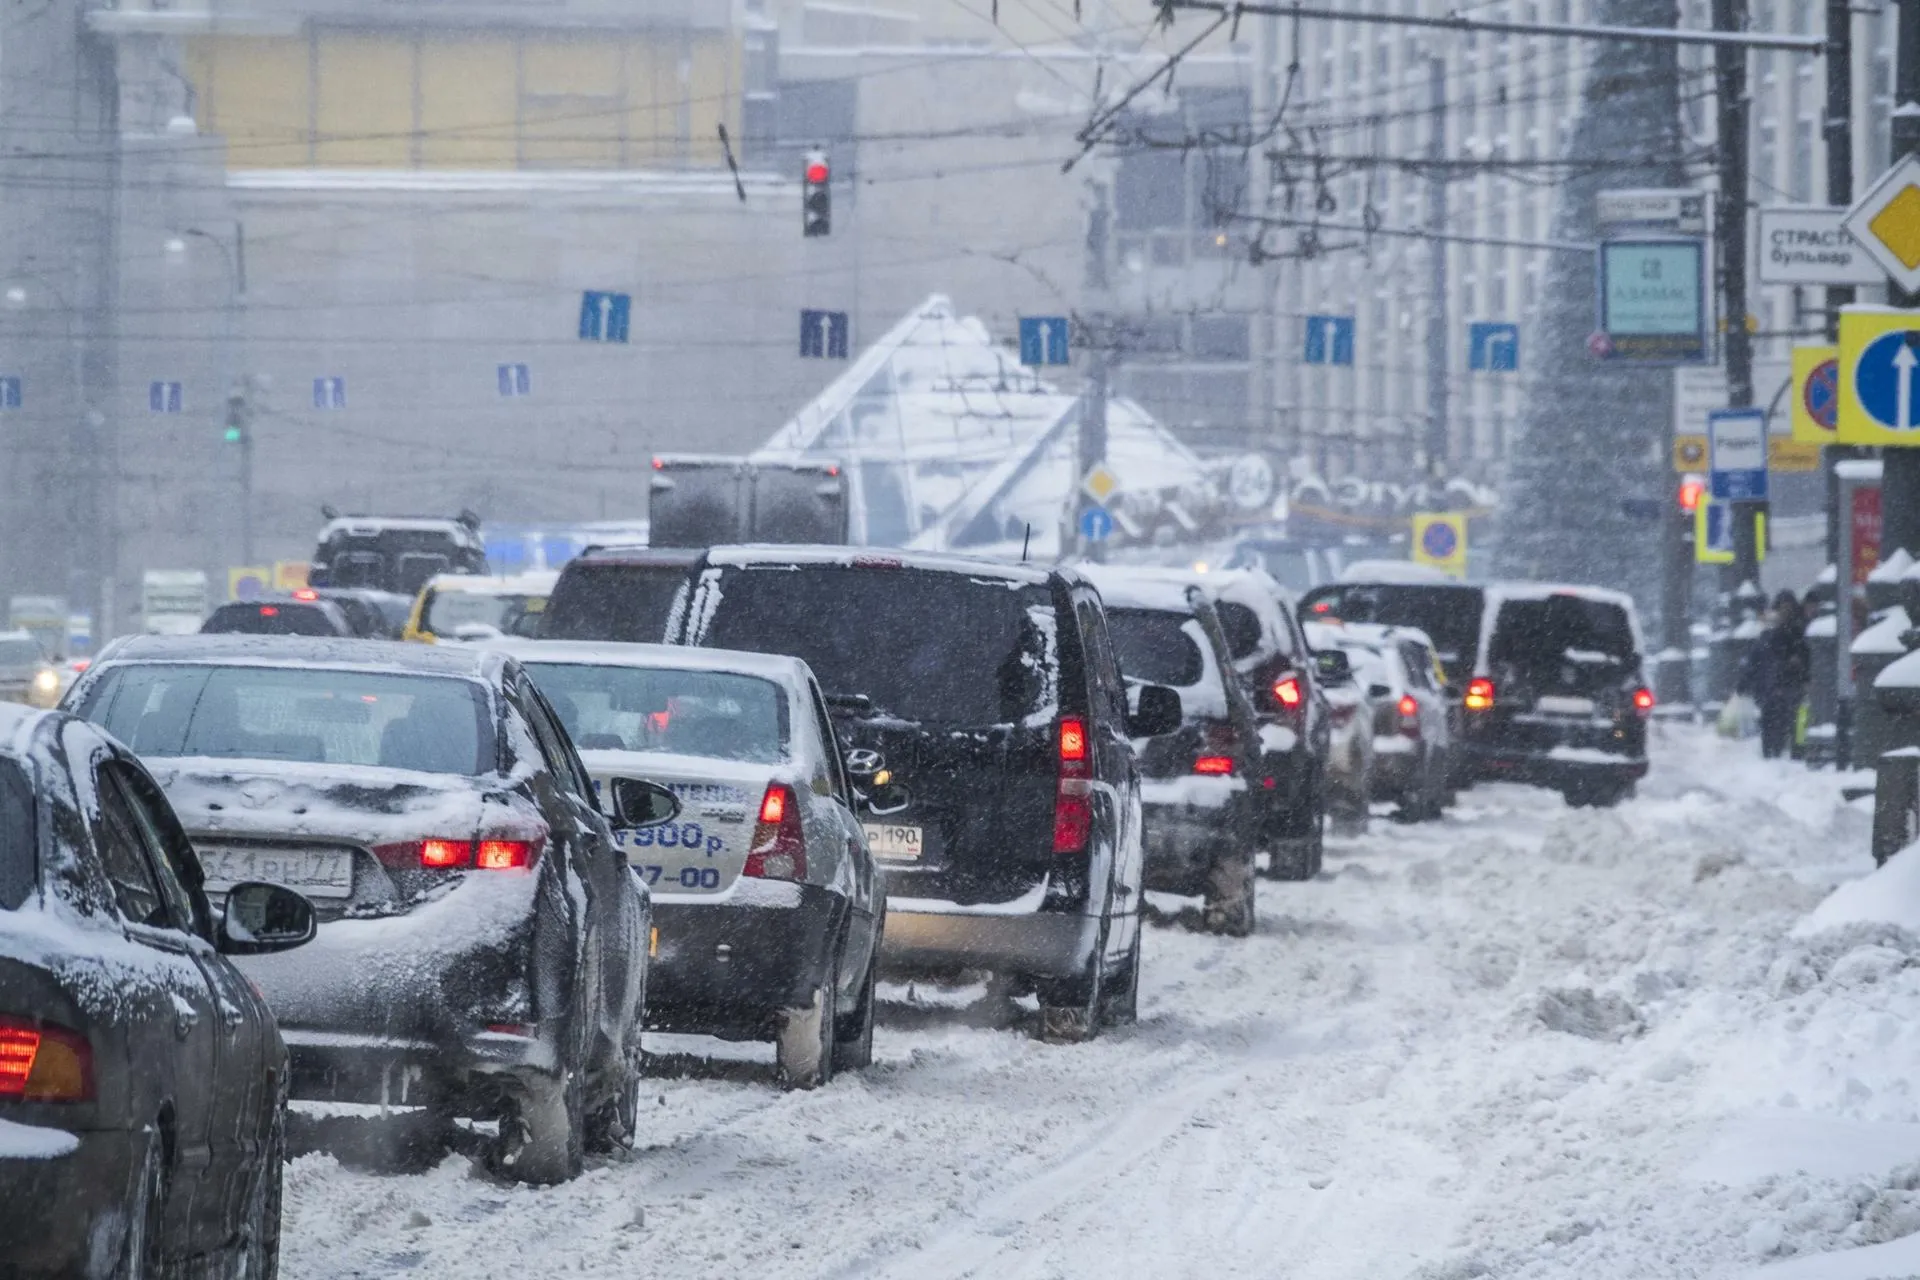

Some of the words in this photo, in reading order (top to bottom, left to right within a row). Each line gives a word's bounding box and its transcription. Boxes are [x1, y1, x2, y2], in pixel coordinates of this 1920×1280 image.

[1770, 229, 1855, 246] СТРАСТ
[1770, 245, 1853, 268] бульвар
[885, 827, 917, 845] 190
